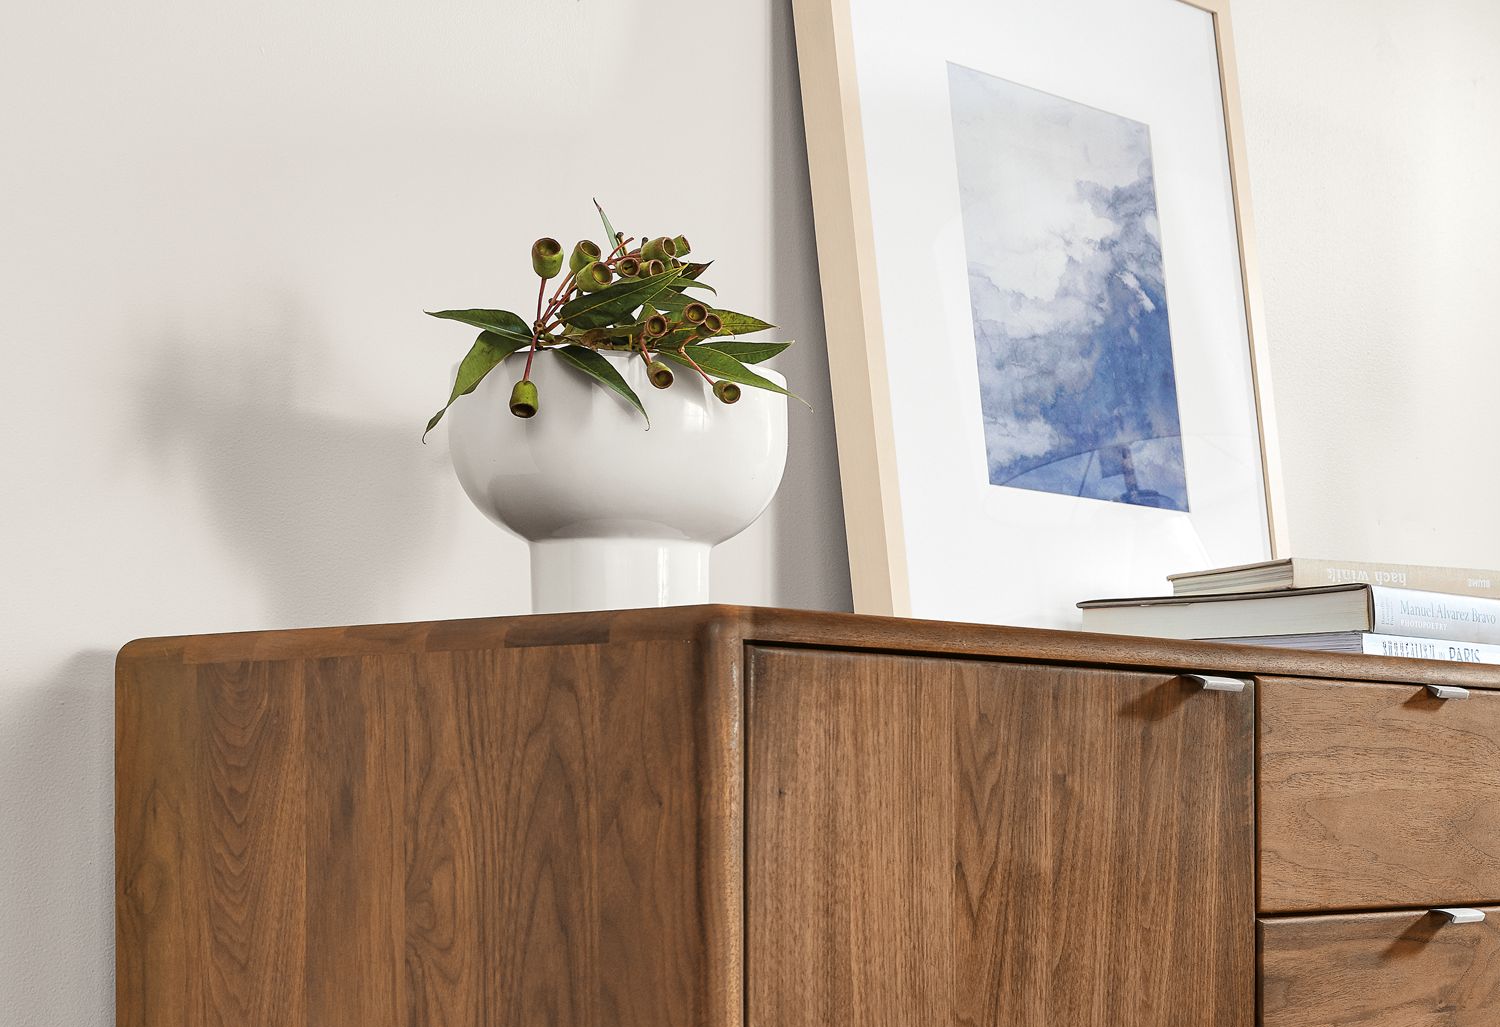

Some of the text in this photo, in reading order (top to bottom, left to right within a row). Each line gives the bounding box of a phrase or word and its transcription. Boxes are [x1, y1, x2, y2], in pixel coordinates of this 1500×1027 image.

[1400, 600, 1435, 617] Manuel
[1437, 603, 1469, 622] Alvarez
[1471, 608, 1497, 625] Bravo
[1400, 619, 1448, 632] PHOTOPOETRY
[1448, 646, 1481, 663] PARIS
